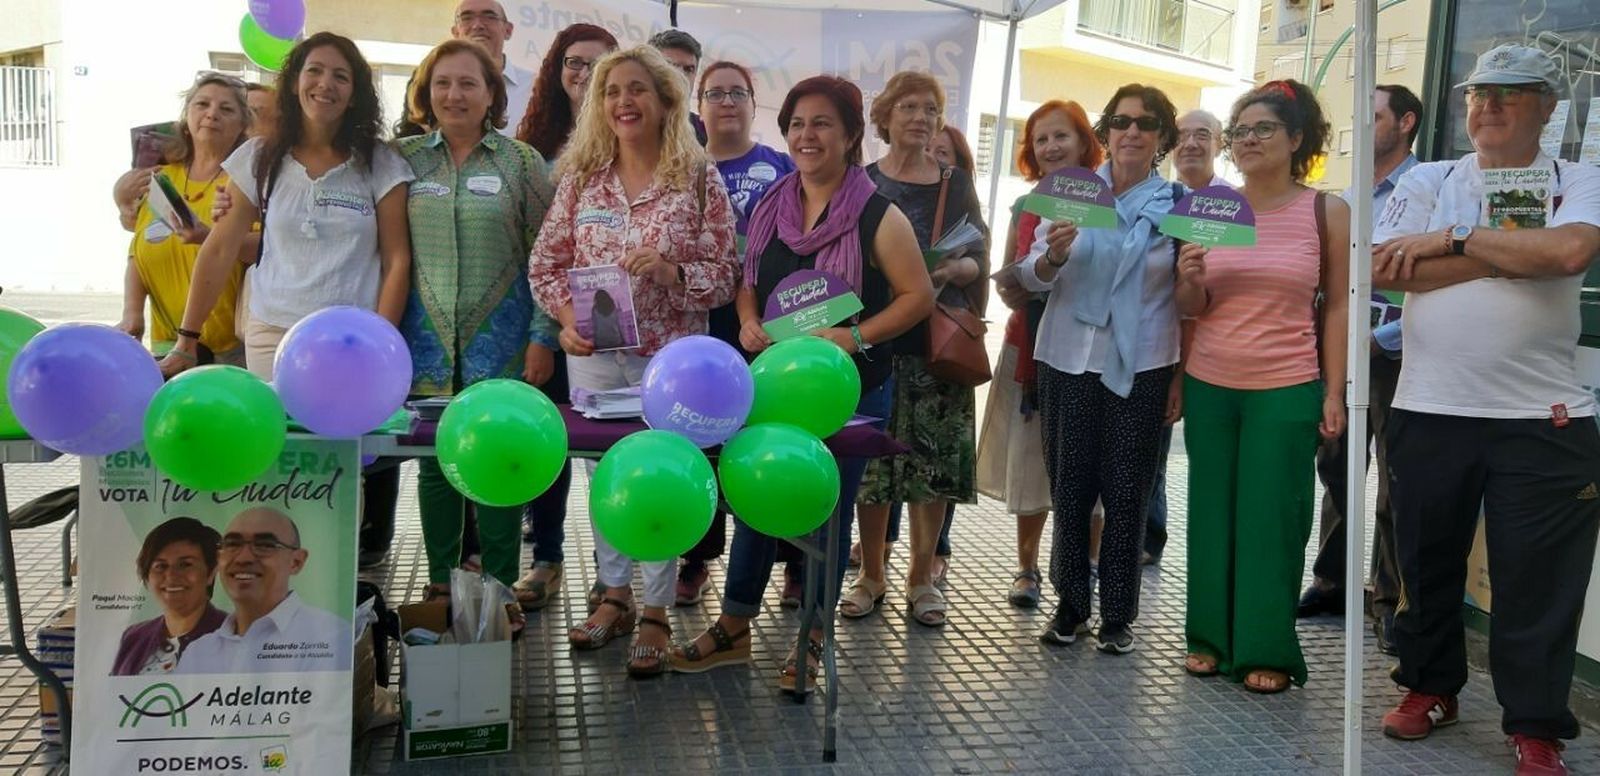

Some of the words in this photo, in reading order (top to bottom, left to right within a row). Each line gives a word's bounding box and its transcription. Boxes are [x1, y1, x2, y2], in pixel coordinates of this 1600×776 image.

[1054, 175, 1101, 191] RECUPERA
[1501, 169, 1550, 180] RECUPERA
[1192, 195, 1241, 210] RECUPERA
[1202, 203, 1241, 220] Ciudad
[777, 277, 827, 302] RECUPERA
[793, 281, 829, 306] Ciudad
[671, 401, 738, 427] RECUPERA
[99, 488, 149, 502] VOTA
[162, 478, 199, 514] Tu
[263, 641, 298, 650] Eduardo
[207, 685, 312, 707] Adelante
[210, 710, 292, 727] MÁLAG
[138, 756, 248, 773] PODEMOS.
